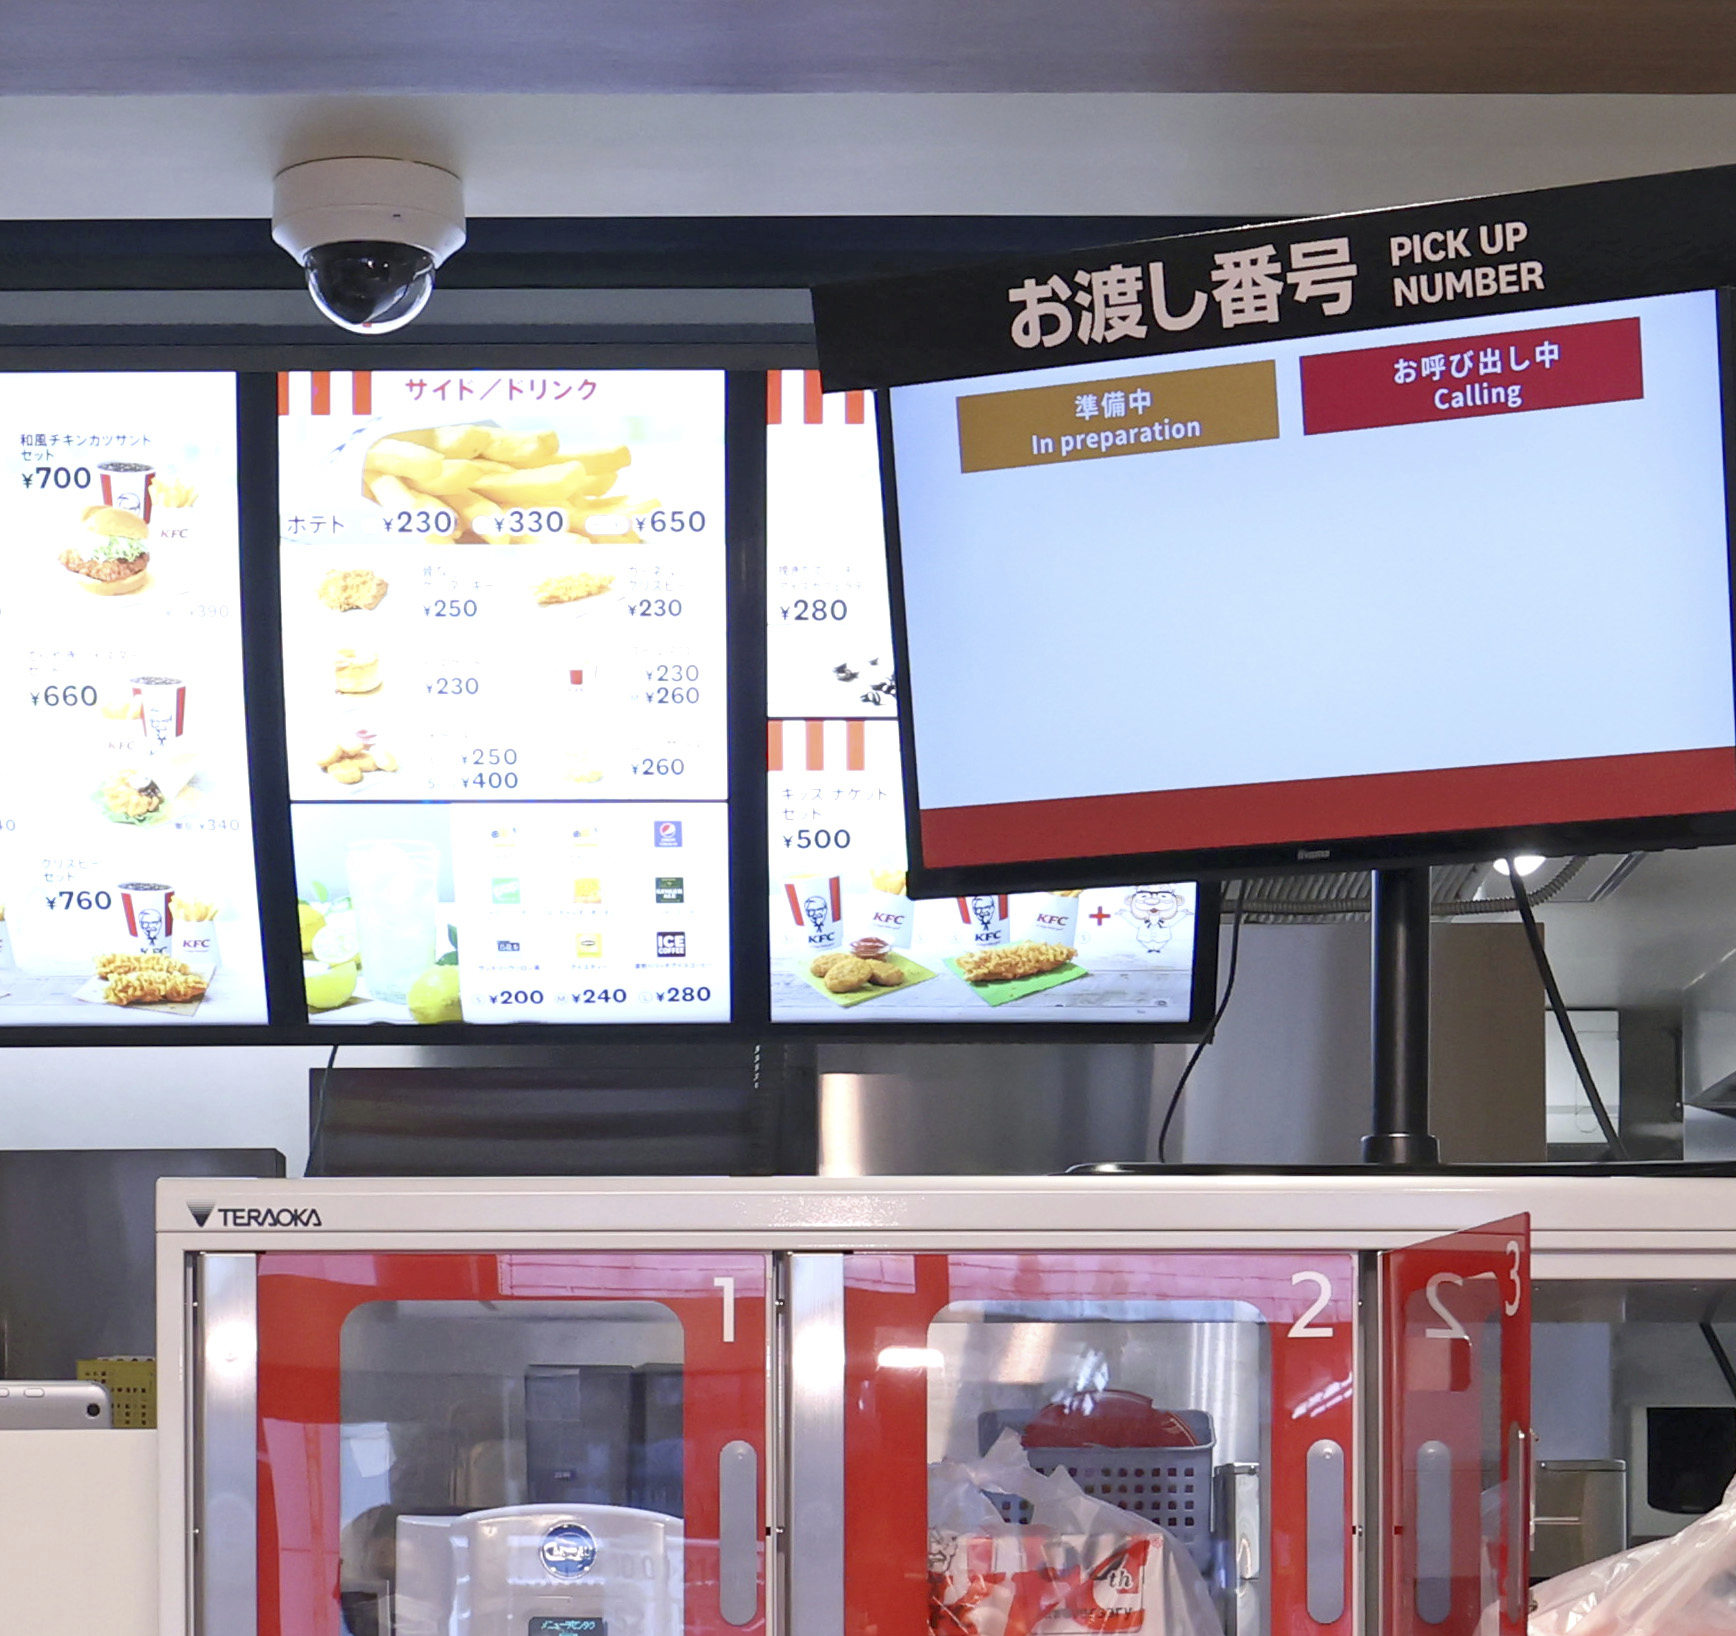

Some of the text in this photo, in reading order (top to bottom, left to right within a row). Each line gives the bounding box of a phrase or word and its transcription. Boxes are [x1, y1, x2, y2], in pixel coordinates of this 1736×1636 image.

[1389, 220, 1530, 268] PICK UP
[1008, 234, 1360, 352] お渡し番号
[1392, 258, 1547, 309] NUMBER
[1392, 339, 1562, 387] お呼び出し中
[1075, 388, 1152, 421] 準備中
[1433, 375, 1524, 414] Calling
[1031, 416, 1202, 456] In preparation
[20, 449, 55, 462] セット
[21, 465, 92, 490] ¥700
[382, 510, 454, 534] ¥230
[494, 510, 565, 534] ¥330
[635, 510, 707, 534] ¥650
[160, 528, 189, 539] KFC
[423, 599, 479, 619] ¥250
[627, 599, 683, 619] ¥230
[780, 599, 848, 621] ¥280
[646, 664, 699, 683] ¥230
[29, 683, 98, 707] ¥660
[426, 677, 480, 696] ¥230
[645, 687, 700, 705] ¥260
[462, 747, 518, 767] ¥250
[631, 757, 685, 776] ¥260
[461, 772, 519, 790] ¥400
[783, 829, 851, 849] ¥500
[45, 889, 113, 911] ¥760
[873, 911, 907, 927] KFC
[1036, 911, 1070, 928] KFC
[183, 938, 212, 950] KFC
[657, 934, 685, 949] ICE
[808, 930, 837, 946] KFC
[974, 929, 1003, 943] KFC
[489, 989, 544, 1006] ¥200
[571, 988, 627, 1004] ¥240
[655, 986, 711, 1002] ¥280
[218, 1208, 322, 1227] TERAOKA
[1505, 1239, 1521, 1317] 3
[713, 1277, 735, 1343] 1
[1287, 1271, 1334, 1339] 2
